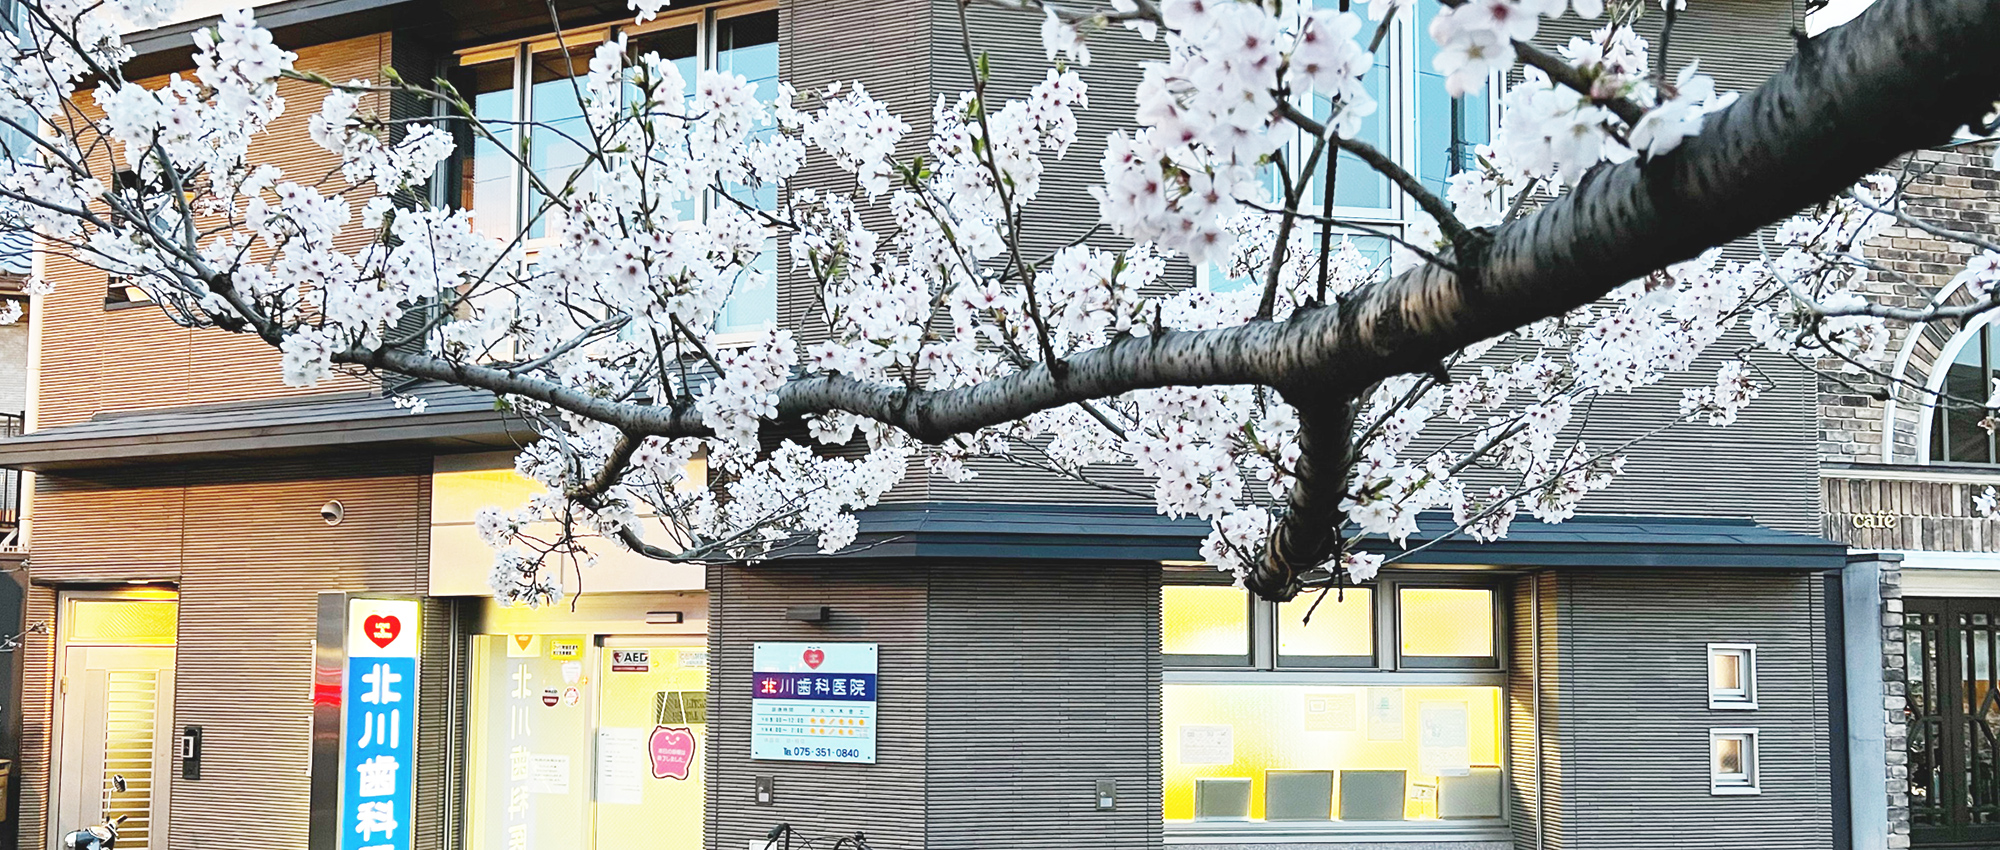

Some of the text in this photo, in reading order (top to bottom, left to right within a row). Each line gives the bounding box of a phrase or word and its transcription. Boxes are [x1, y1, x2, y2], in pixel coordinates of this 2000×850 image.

[1853, 509, 1897, 529] café
[624, 652, 648, 662] AED
[761, 677, 866, 697] 北川歯科医院
[355, 663, 402, 850] 北川歯科
